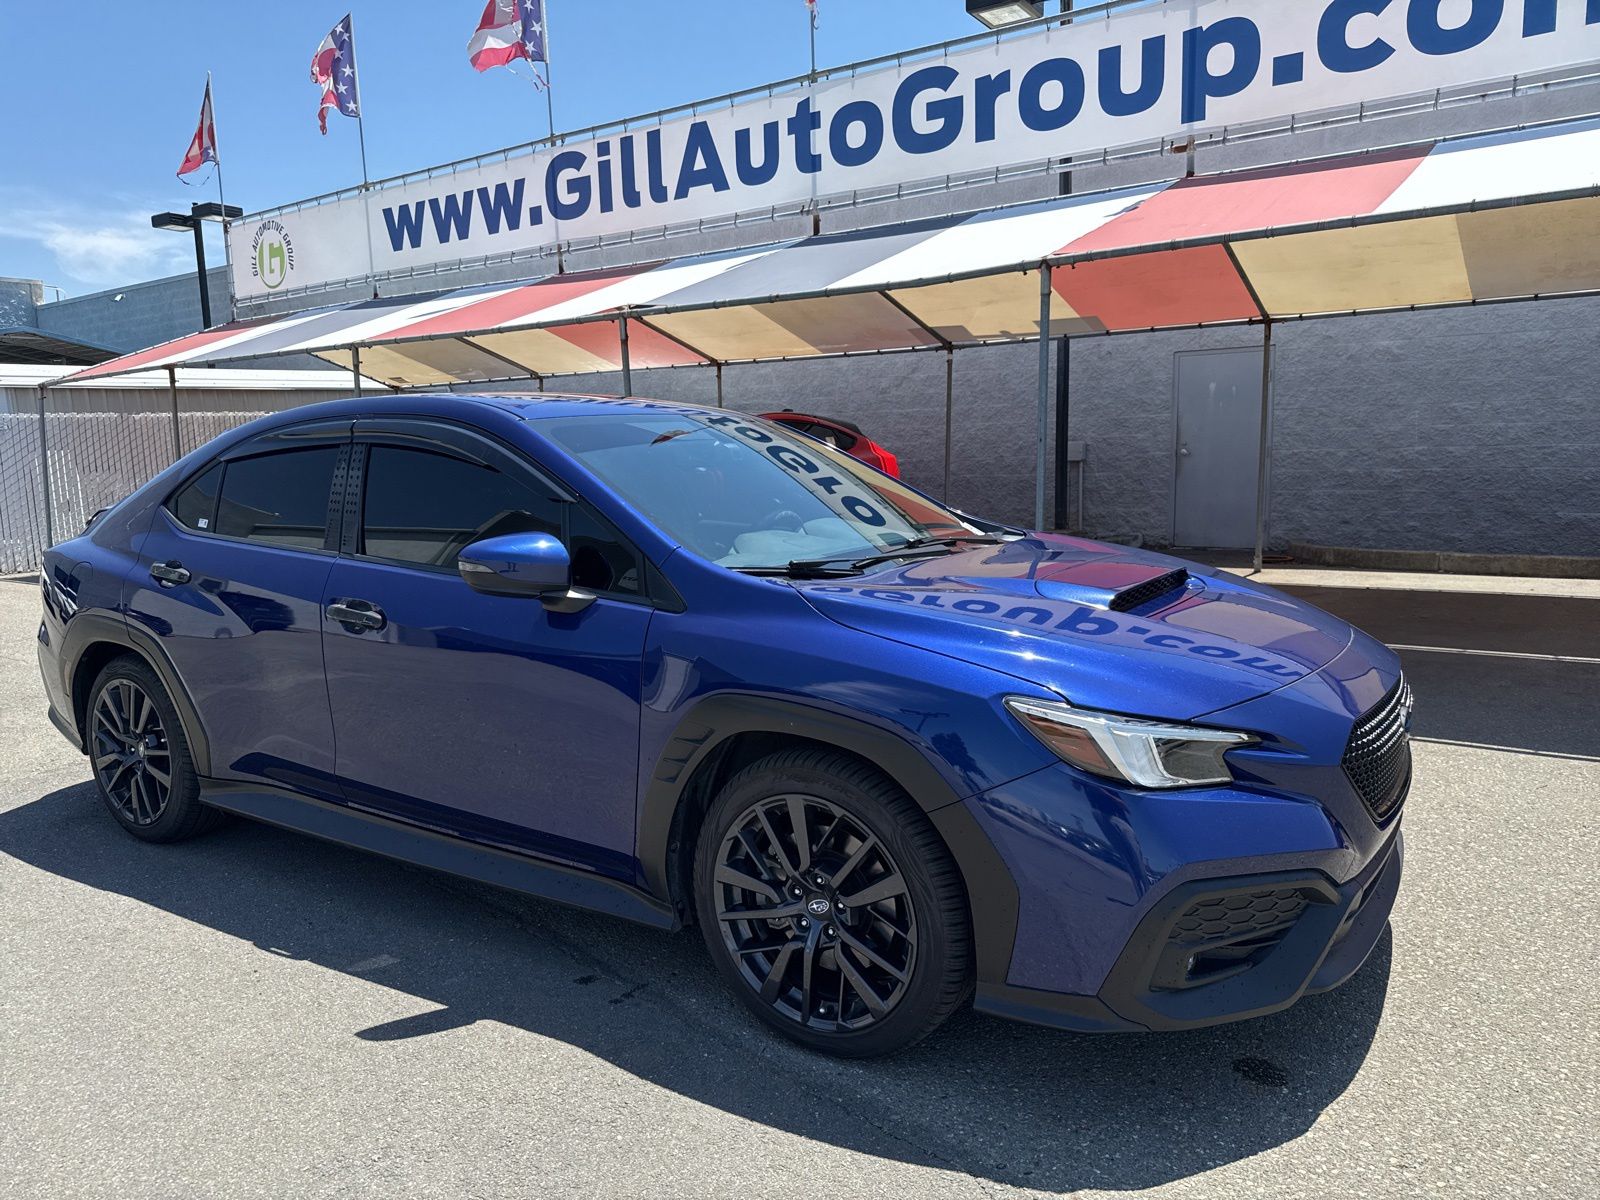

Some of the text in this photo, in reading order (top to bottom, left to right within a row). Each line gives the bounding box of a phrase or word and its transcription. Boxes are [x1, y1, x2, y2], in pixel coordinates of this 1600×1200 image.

[382, 0, 1600, 252] www.GillAutoGroup.co
[251, 220, 295, 277] GILL AUTOMOTIVE GROUP
